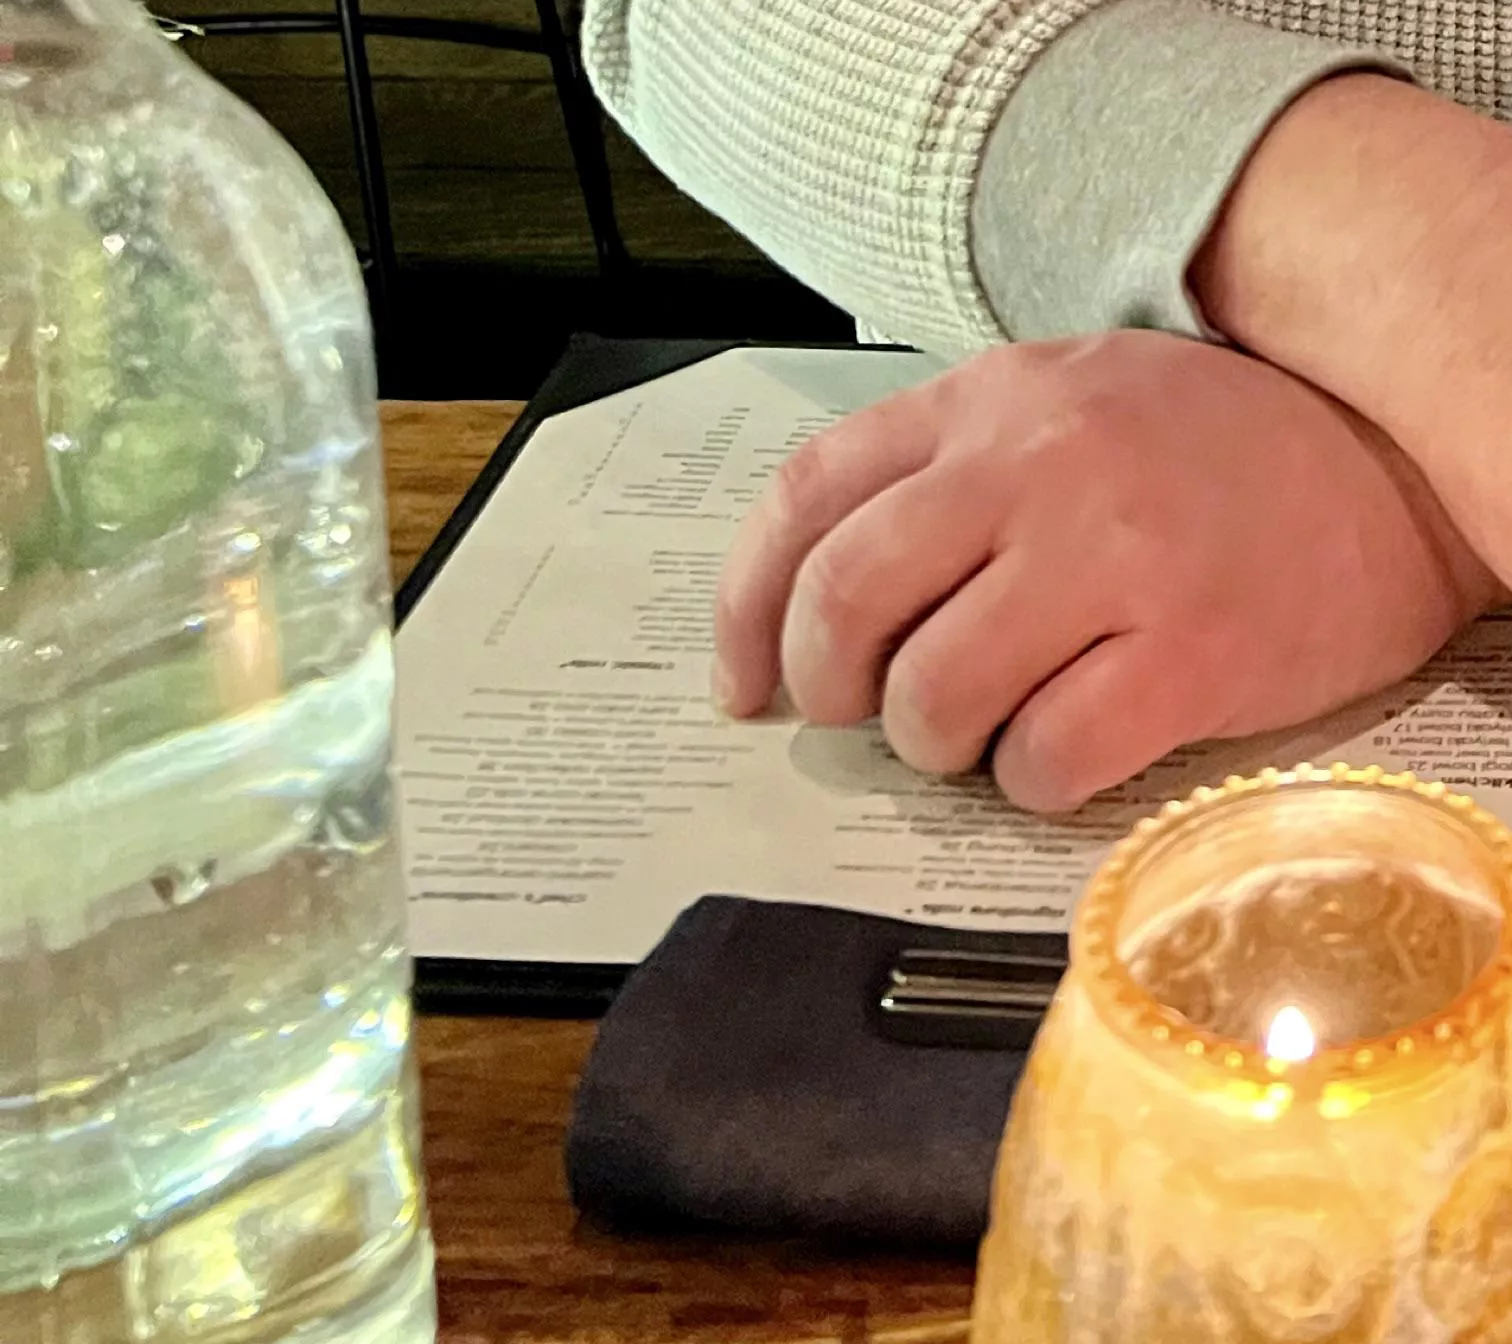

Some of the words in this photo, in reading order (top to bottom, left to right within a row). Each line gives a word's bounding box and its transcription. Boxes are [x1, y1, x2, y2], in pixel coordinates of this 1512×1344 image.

[1417, 723, 1461, 732] bowl
[1399, 736, 1442, 746] bowl
[1447, 735, 1510, 748] teriyaki
[1431, 762, 1476, 772] bowl
